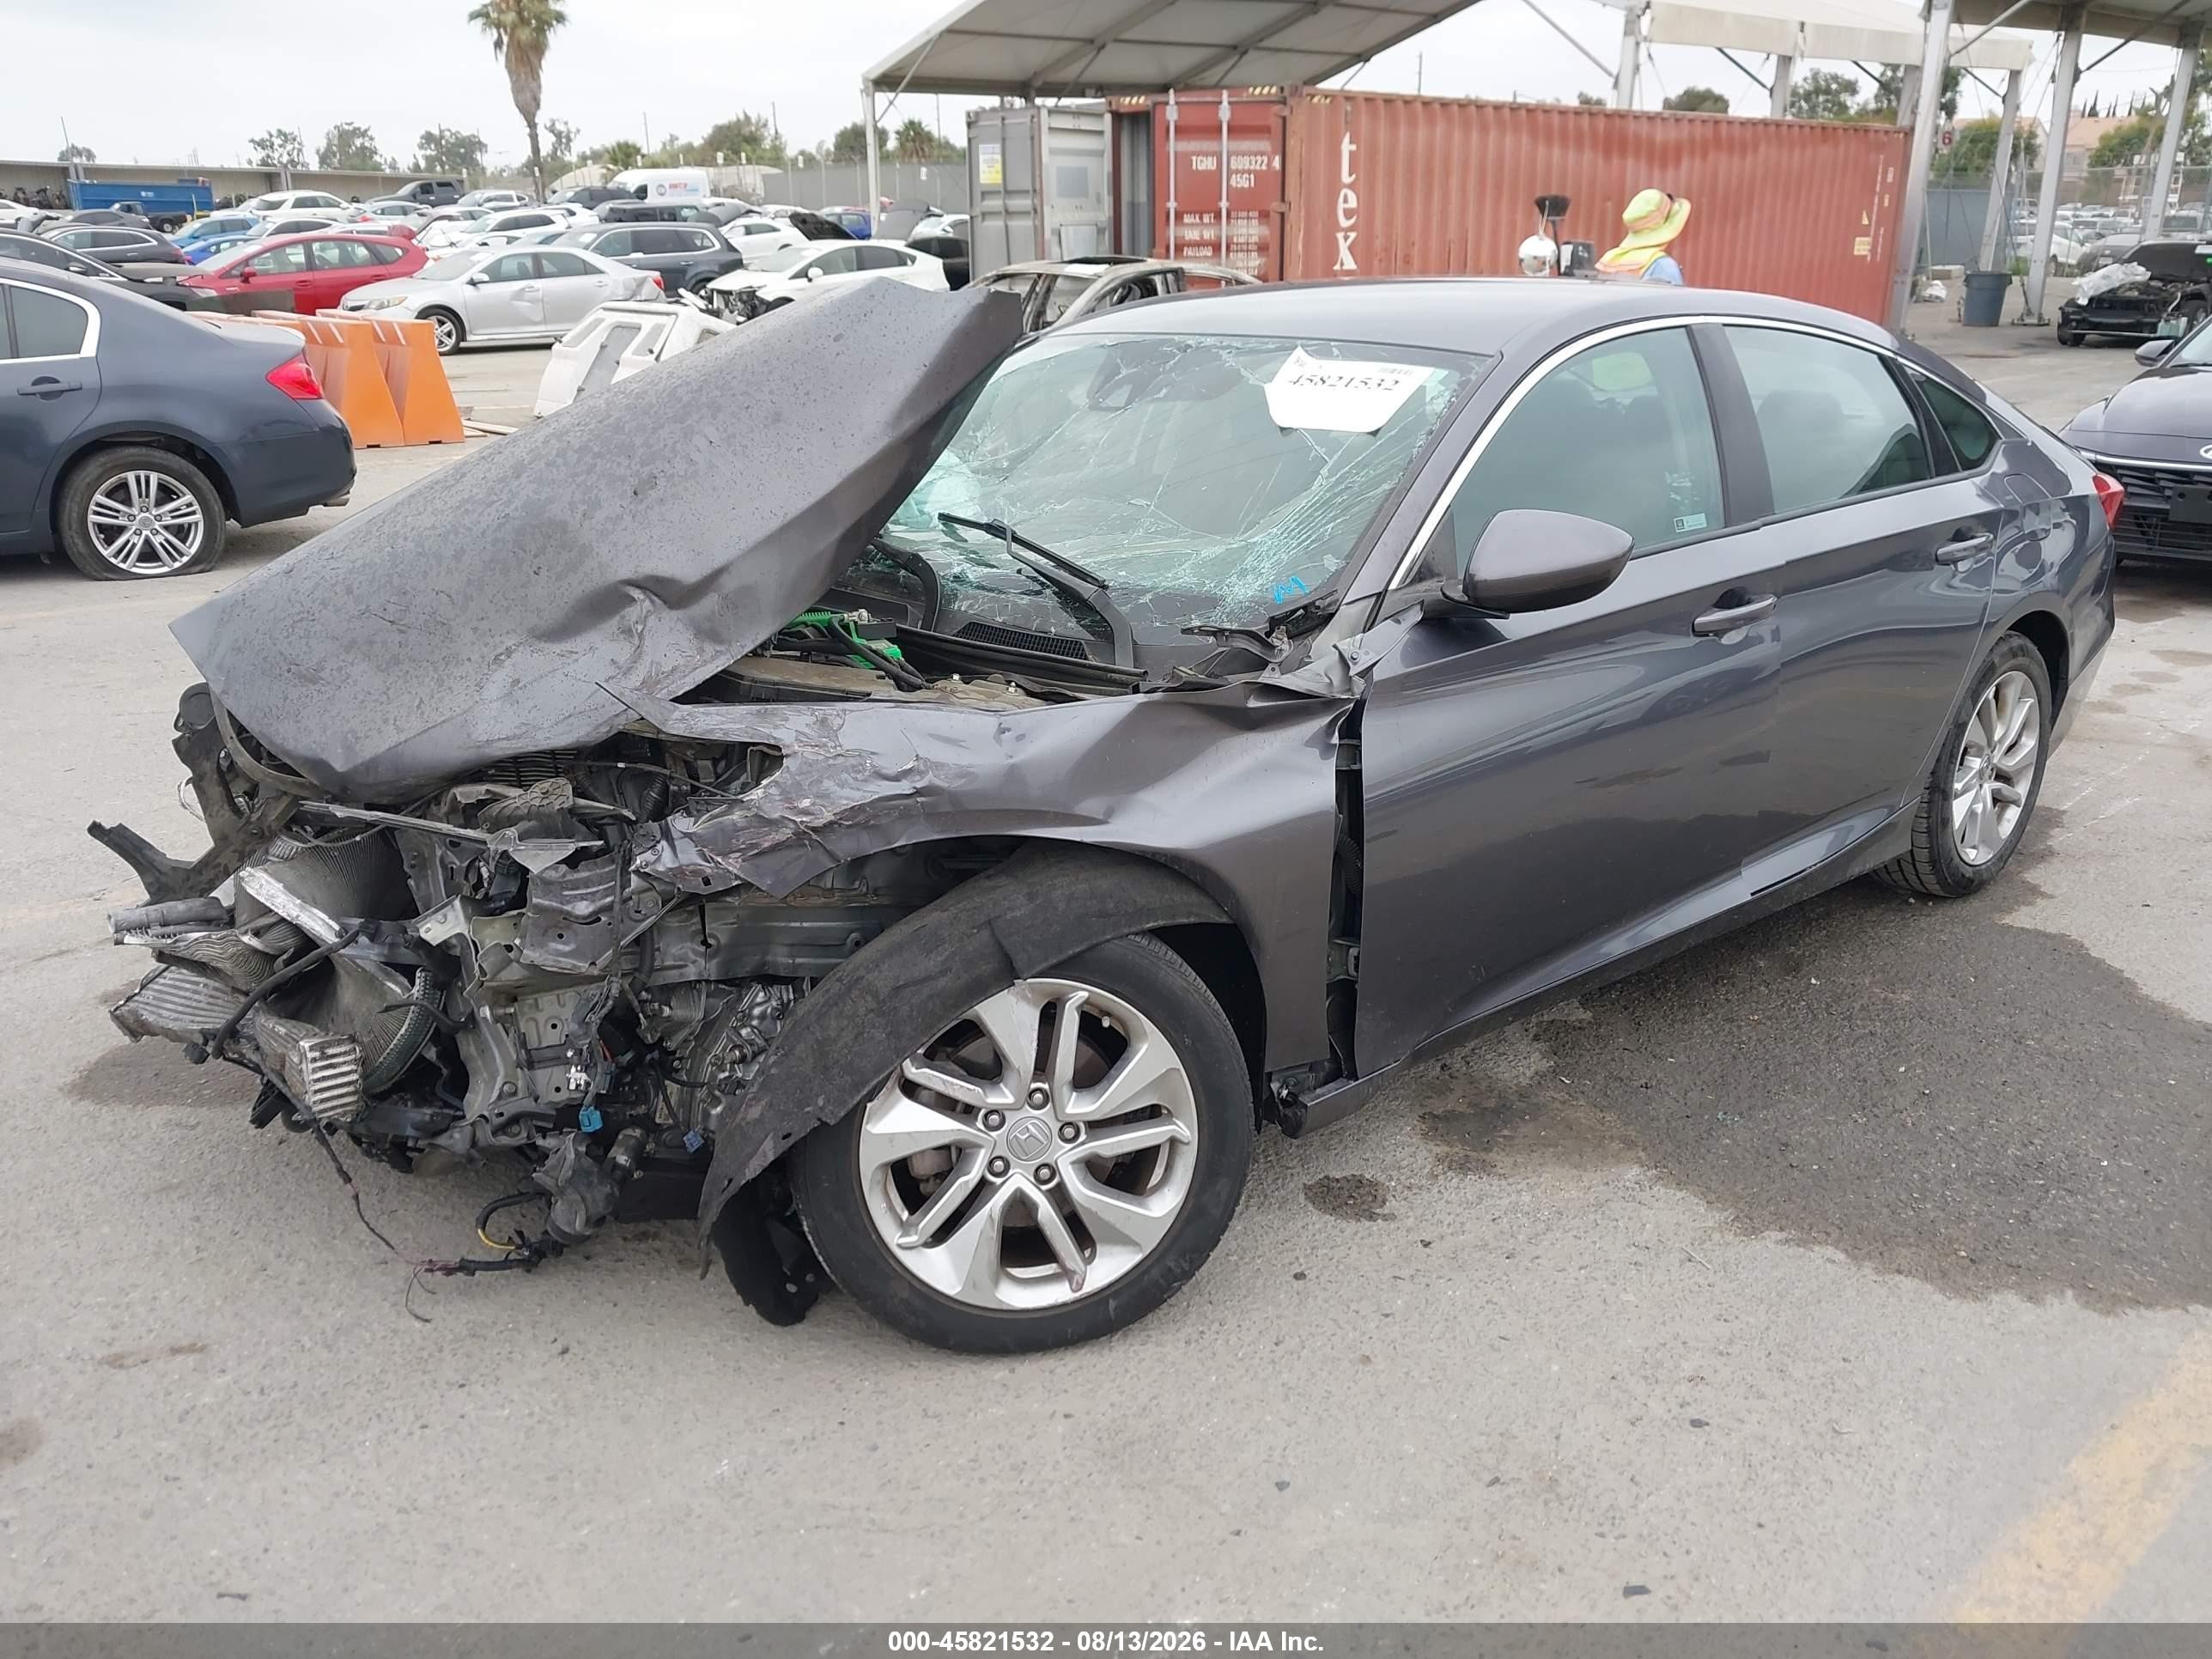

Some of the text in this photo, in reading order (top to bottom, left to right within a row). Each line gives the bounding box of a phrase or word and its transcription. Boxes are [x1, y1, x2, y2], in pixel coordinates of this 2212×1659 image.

[1191, 155, 1217, 170] TGHU
[1230, 173, 1255, 187] 45G1
[1333, 131, 1358, 270] tex
[1183, 246, 1212, 257] PAYLOAD
[1288, 374, 1400, 391] 45821532
